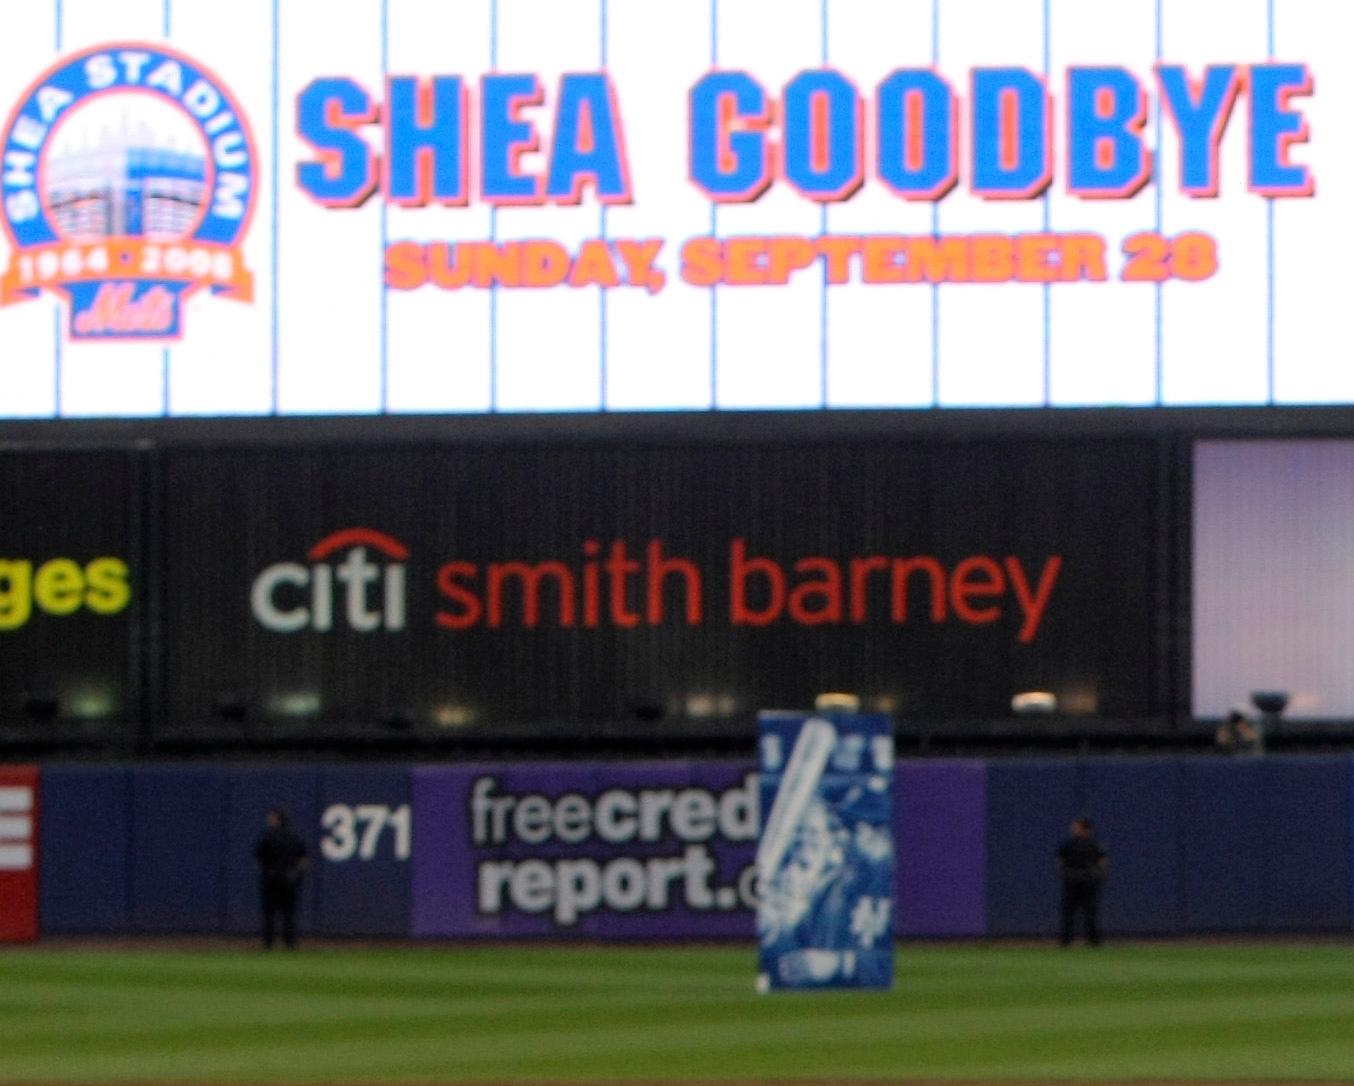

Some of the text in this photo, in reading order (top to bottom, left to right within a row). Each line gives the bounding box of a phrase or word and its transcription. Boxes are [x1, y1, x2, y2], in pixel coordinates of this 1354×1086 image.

[3, 51, 250, 223] SHEA STADIUM
[295, 61, 1316, 208] SHEA GOODBYE
[385, 238, 666, 296] SUNDAY,
[679, 232, 1108, 287] SEPTEMBER
[0, 556, 131, 631] ges
[250, 536, 1062, 644] citi smith barney
[320, 803, 413, 862] 371
